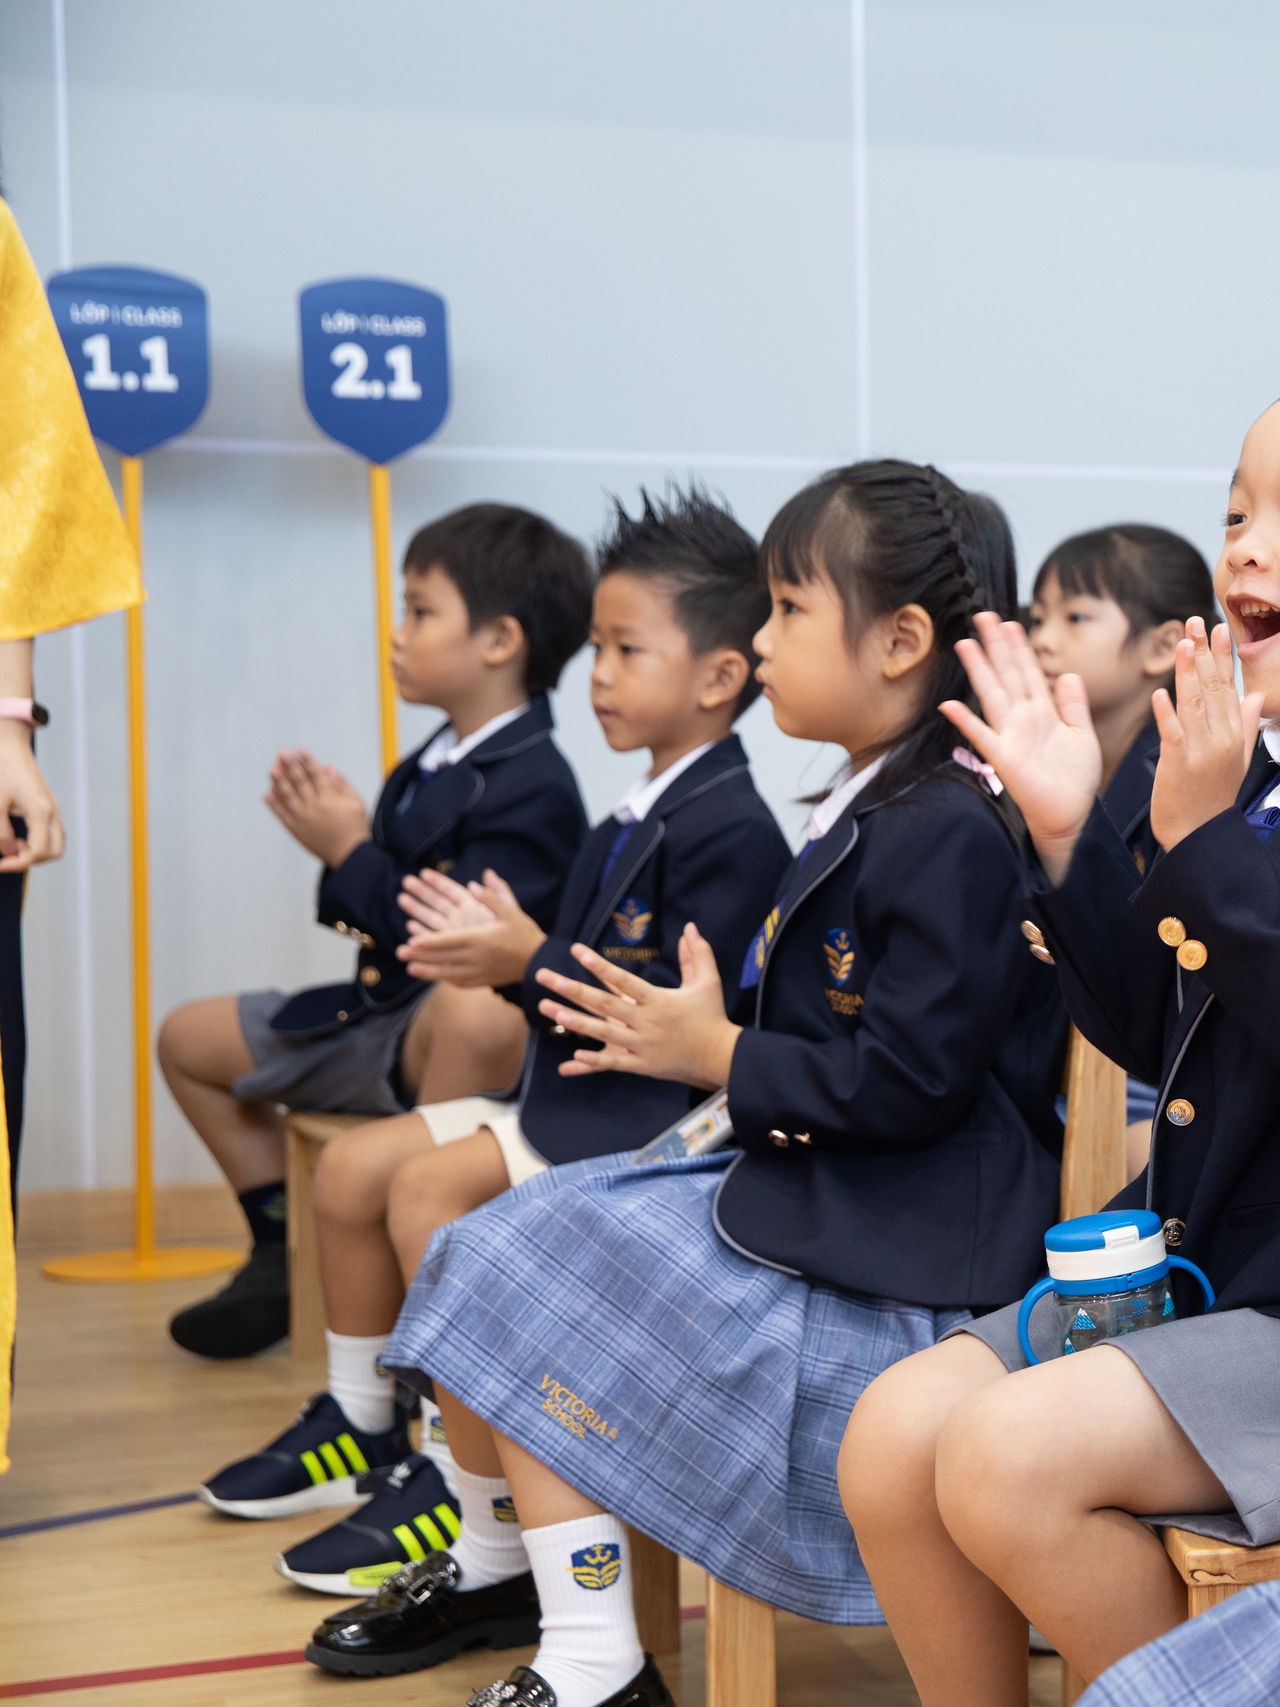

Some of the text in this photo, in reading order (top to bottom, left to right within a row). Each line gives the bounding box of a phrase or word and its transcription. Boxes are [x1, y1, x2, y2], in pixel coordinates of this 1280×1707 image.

[121, 304, 183, 329] CLASS
[81, 333, 179, 393] 1.1
[329, 342, 422, 400] 2.1
[541, 1373, 608, 1436] VICTORIA
[541, 1398, 587, 1439] SCHOOL
